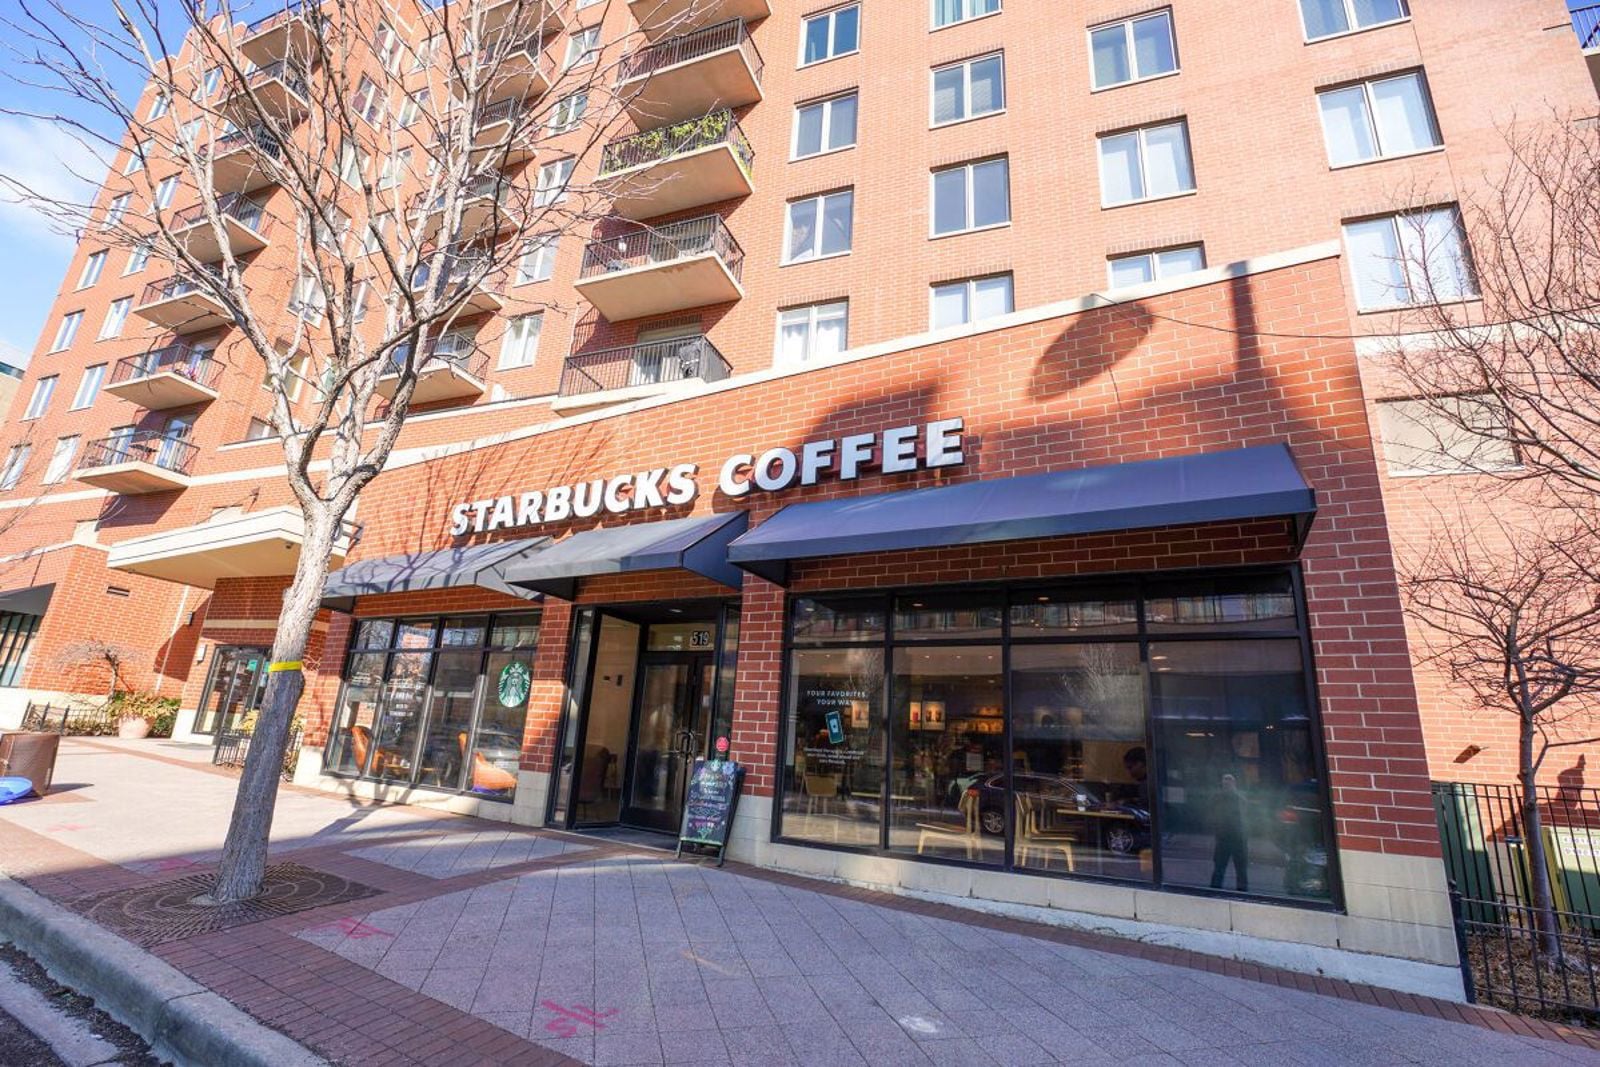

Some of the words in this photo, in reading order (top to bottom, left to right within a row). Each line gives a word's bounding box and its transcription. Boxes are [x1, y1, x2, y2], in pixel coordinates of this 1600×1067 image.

[449, 463, 698, 536] STARBUCKS
[719, 416, 965, 497] COFFEE
[692, 631, 710, 647] 519
